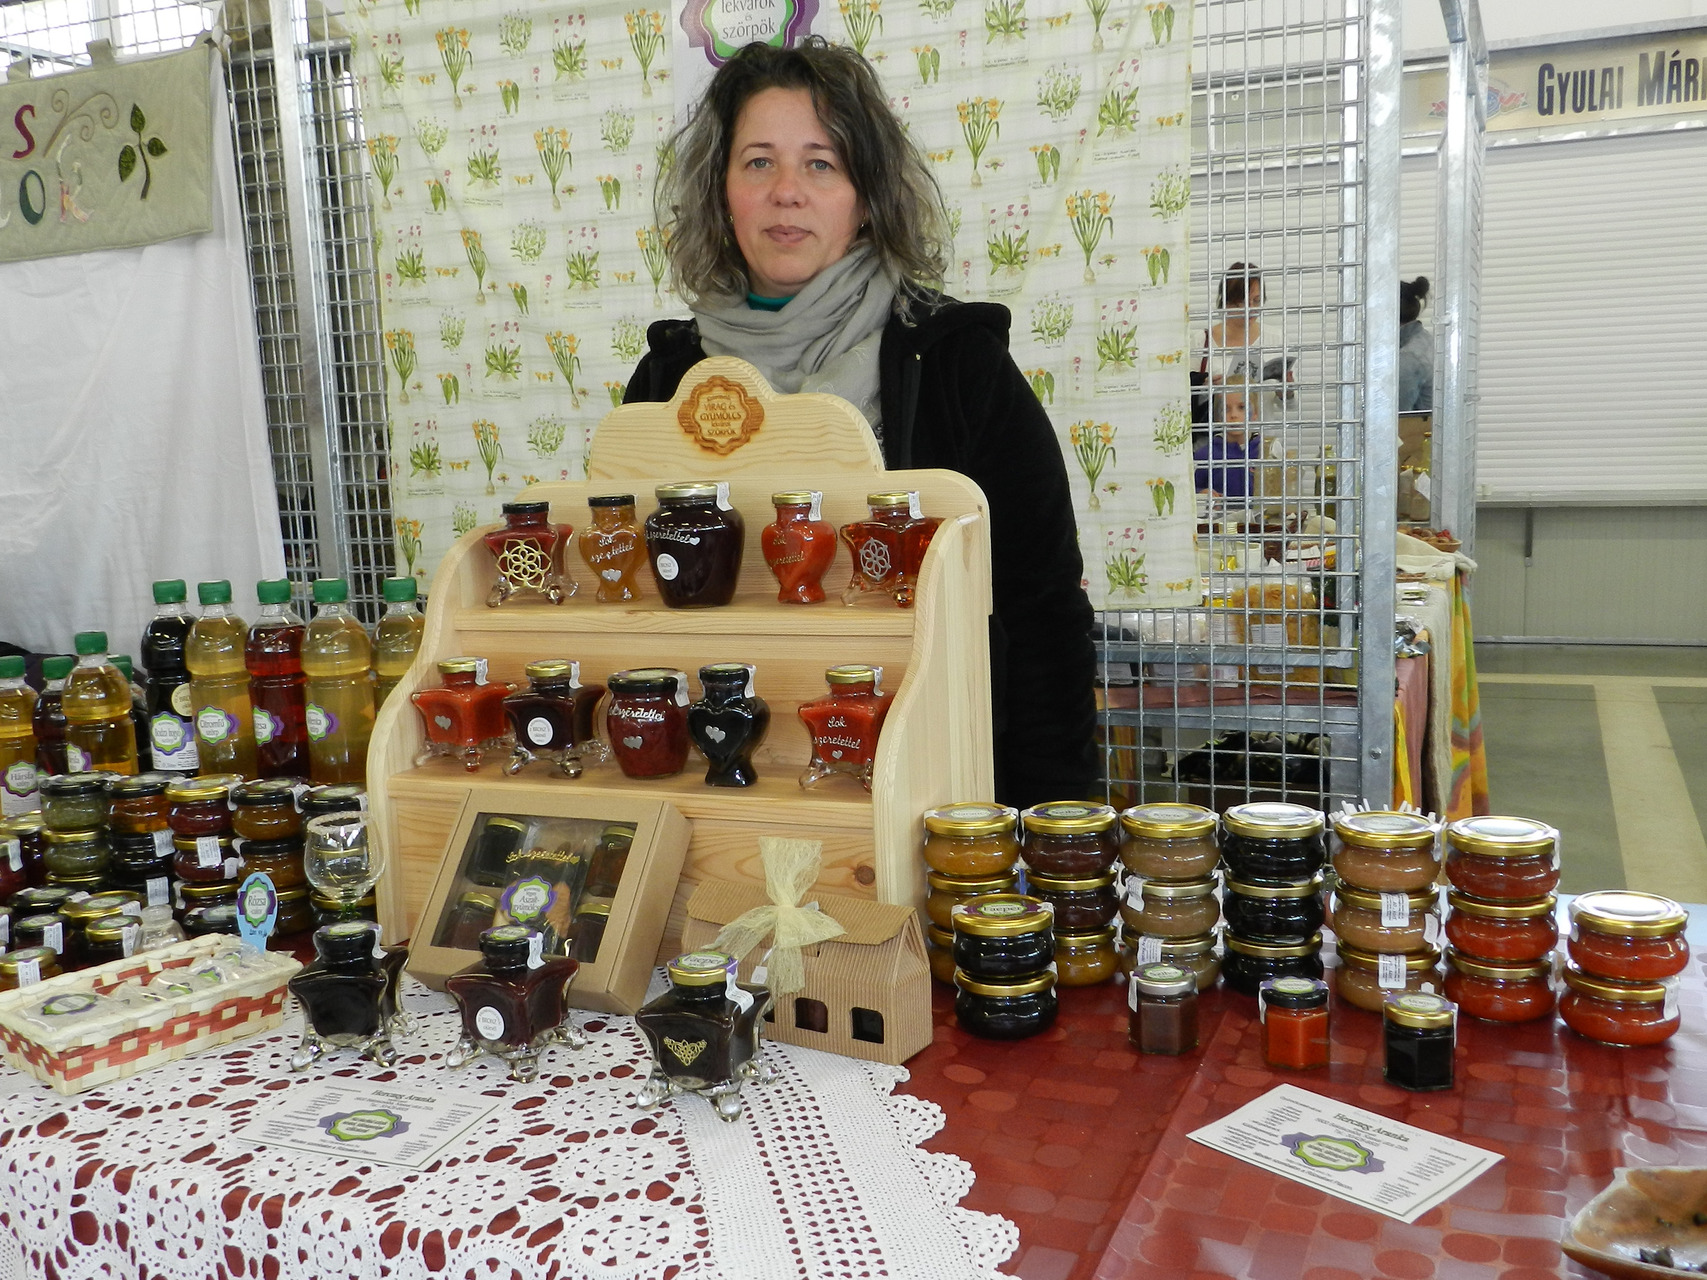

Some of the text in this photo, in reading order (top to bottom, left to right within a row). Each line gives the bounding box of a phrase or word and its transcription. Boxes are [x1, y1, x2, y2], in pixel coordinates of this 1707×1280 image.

[722, 17, 776, 41] szörpök
[1637, 49, 1707, 107] MÁR
[827, 715, 848, 728] Sok
[813, 734, 861, 750] szeretettel
[247, 895, 267, 906] Rózsa
[1373, 1127, 1410, 1142] Aranka
